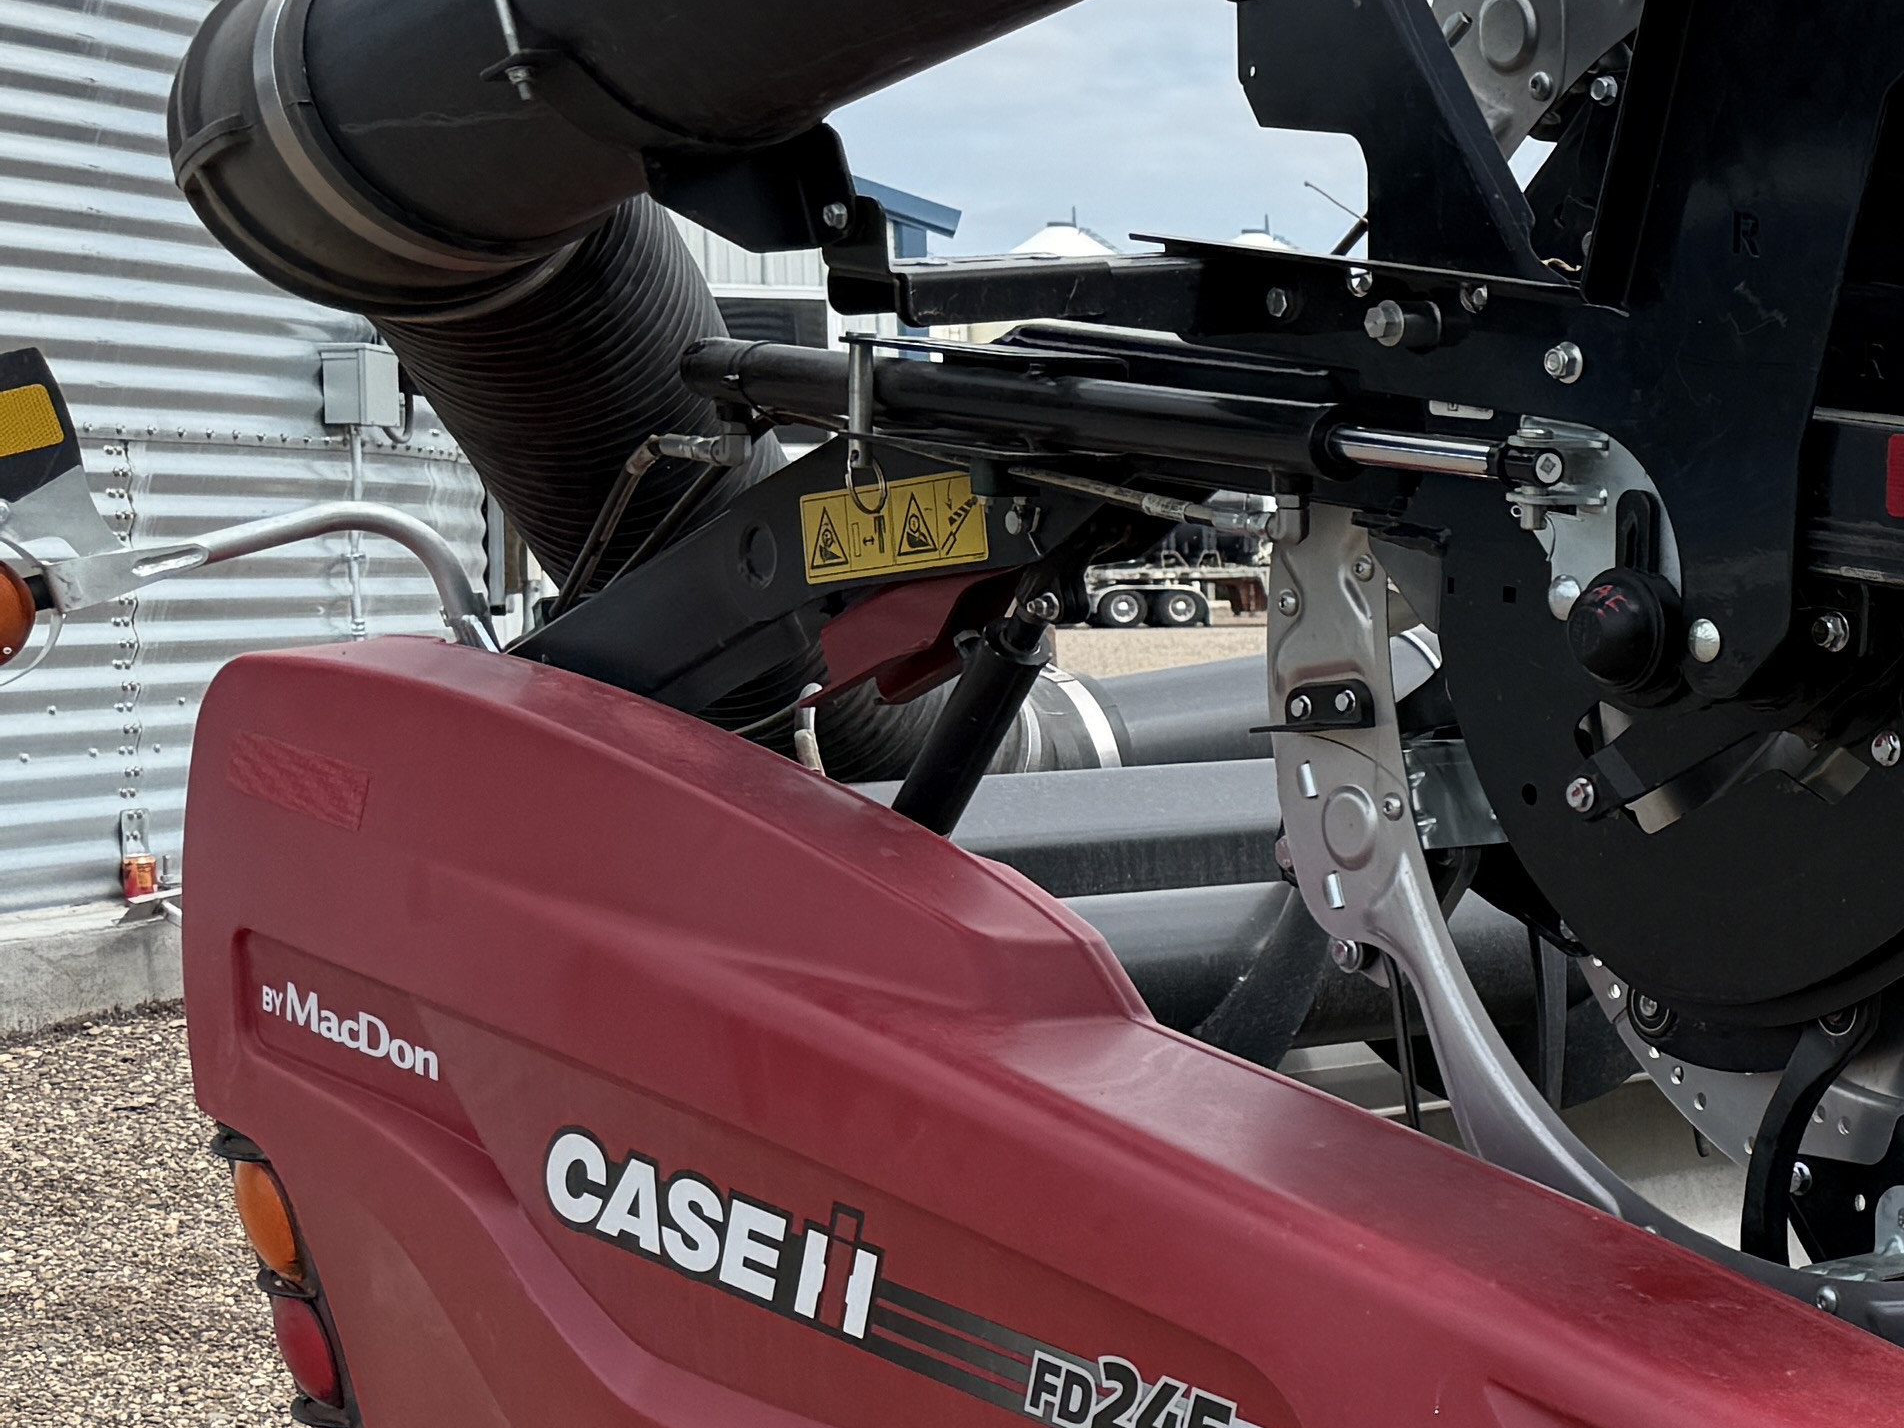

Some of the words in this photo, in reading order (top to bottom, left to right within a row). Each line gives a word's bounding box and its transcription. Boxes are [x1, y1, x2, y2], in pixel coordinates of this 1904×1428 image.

[261, 984, 284, 1015] BY
[285, 981, 439, 1081] MacDon
[545, 1131, 790, 1302] CASE
